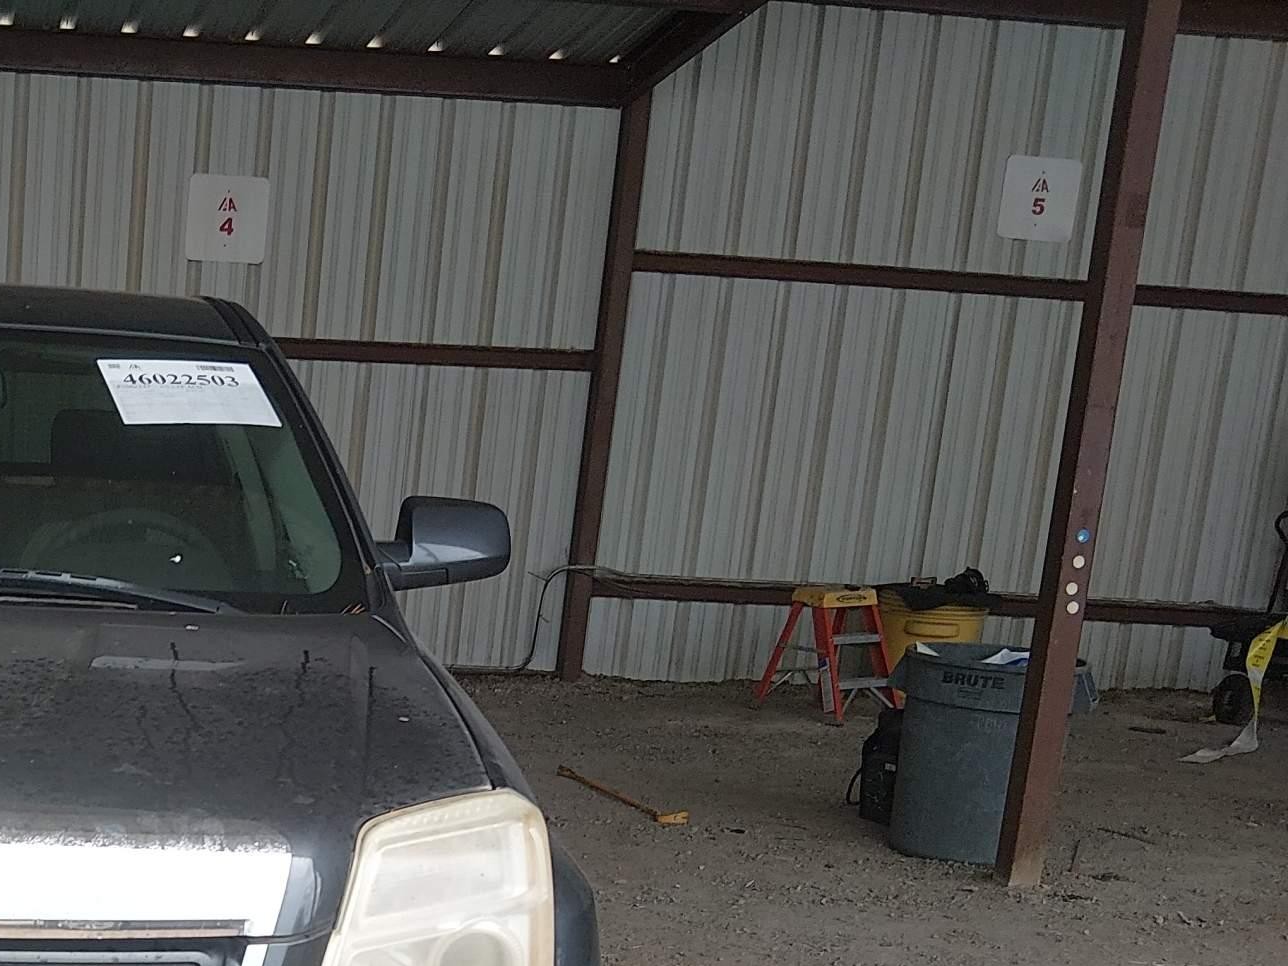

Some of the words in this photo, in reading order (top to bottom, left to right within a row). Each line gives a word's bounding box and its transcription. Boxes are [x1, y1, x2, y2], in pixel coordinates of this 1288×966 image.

[1031, 198, 1046, 215] 5
[219, 217, 234, 236] 4
[123, 373, 240, 388] 46022503
[941, 671, 1006, 690] BRUTE
